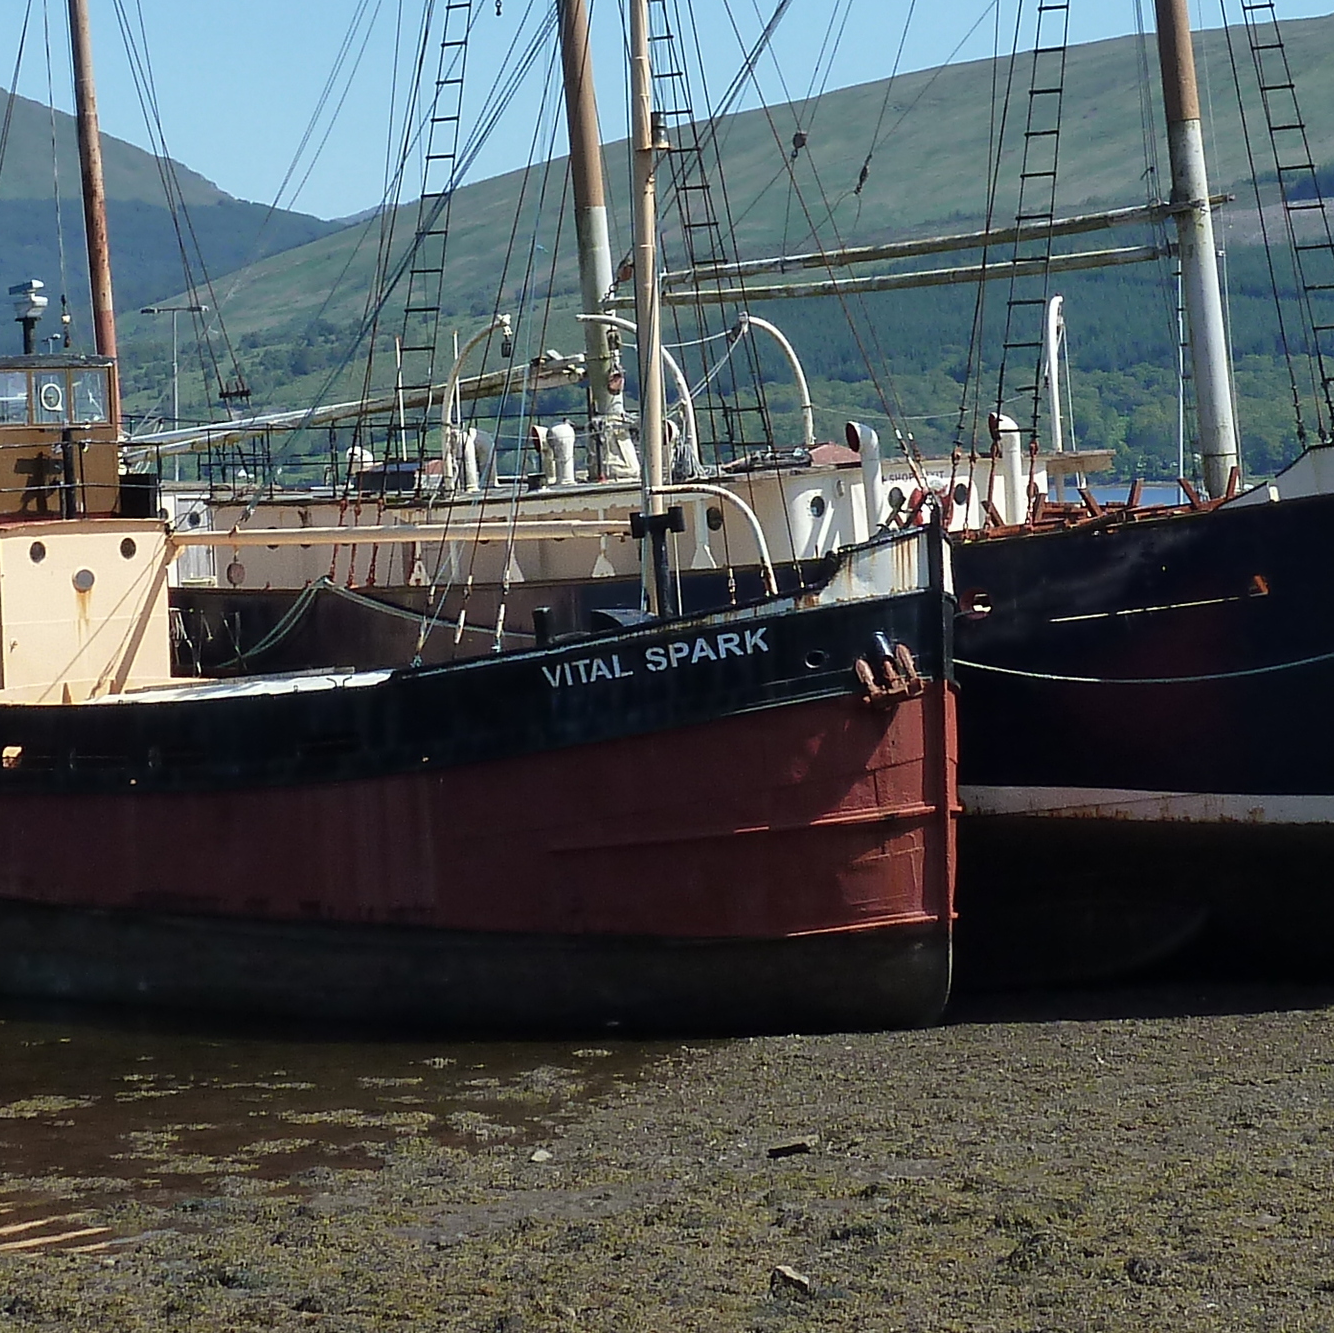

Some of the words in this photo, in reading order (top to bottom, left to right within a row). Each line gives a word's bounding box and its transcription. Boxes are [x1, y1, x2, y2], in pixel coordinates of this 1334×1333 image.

[889, 472, 916, 482] SHOP
[542, 654, 634, 688] VITAL
[645, 627, 769, 672] SPARK
